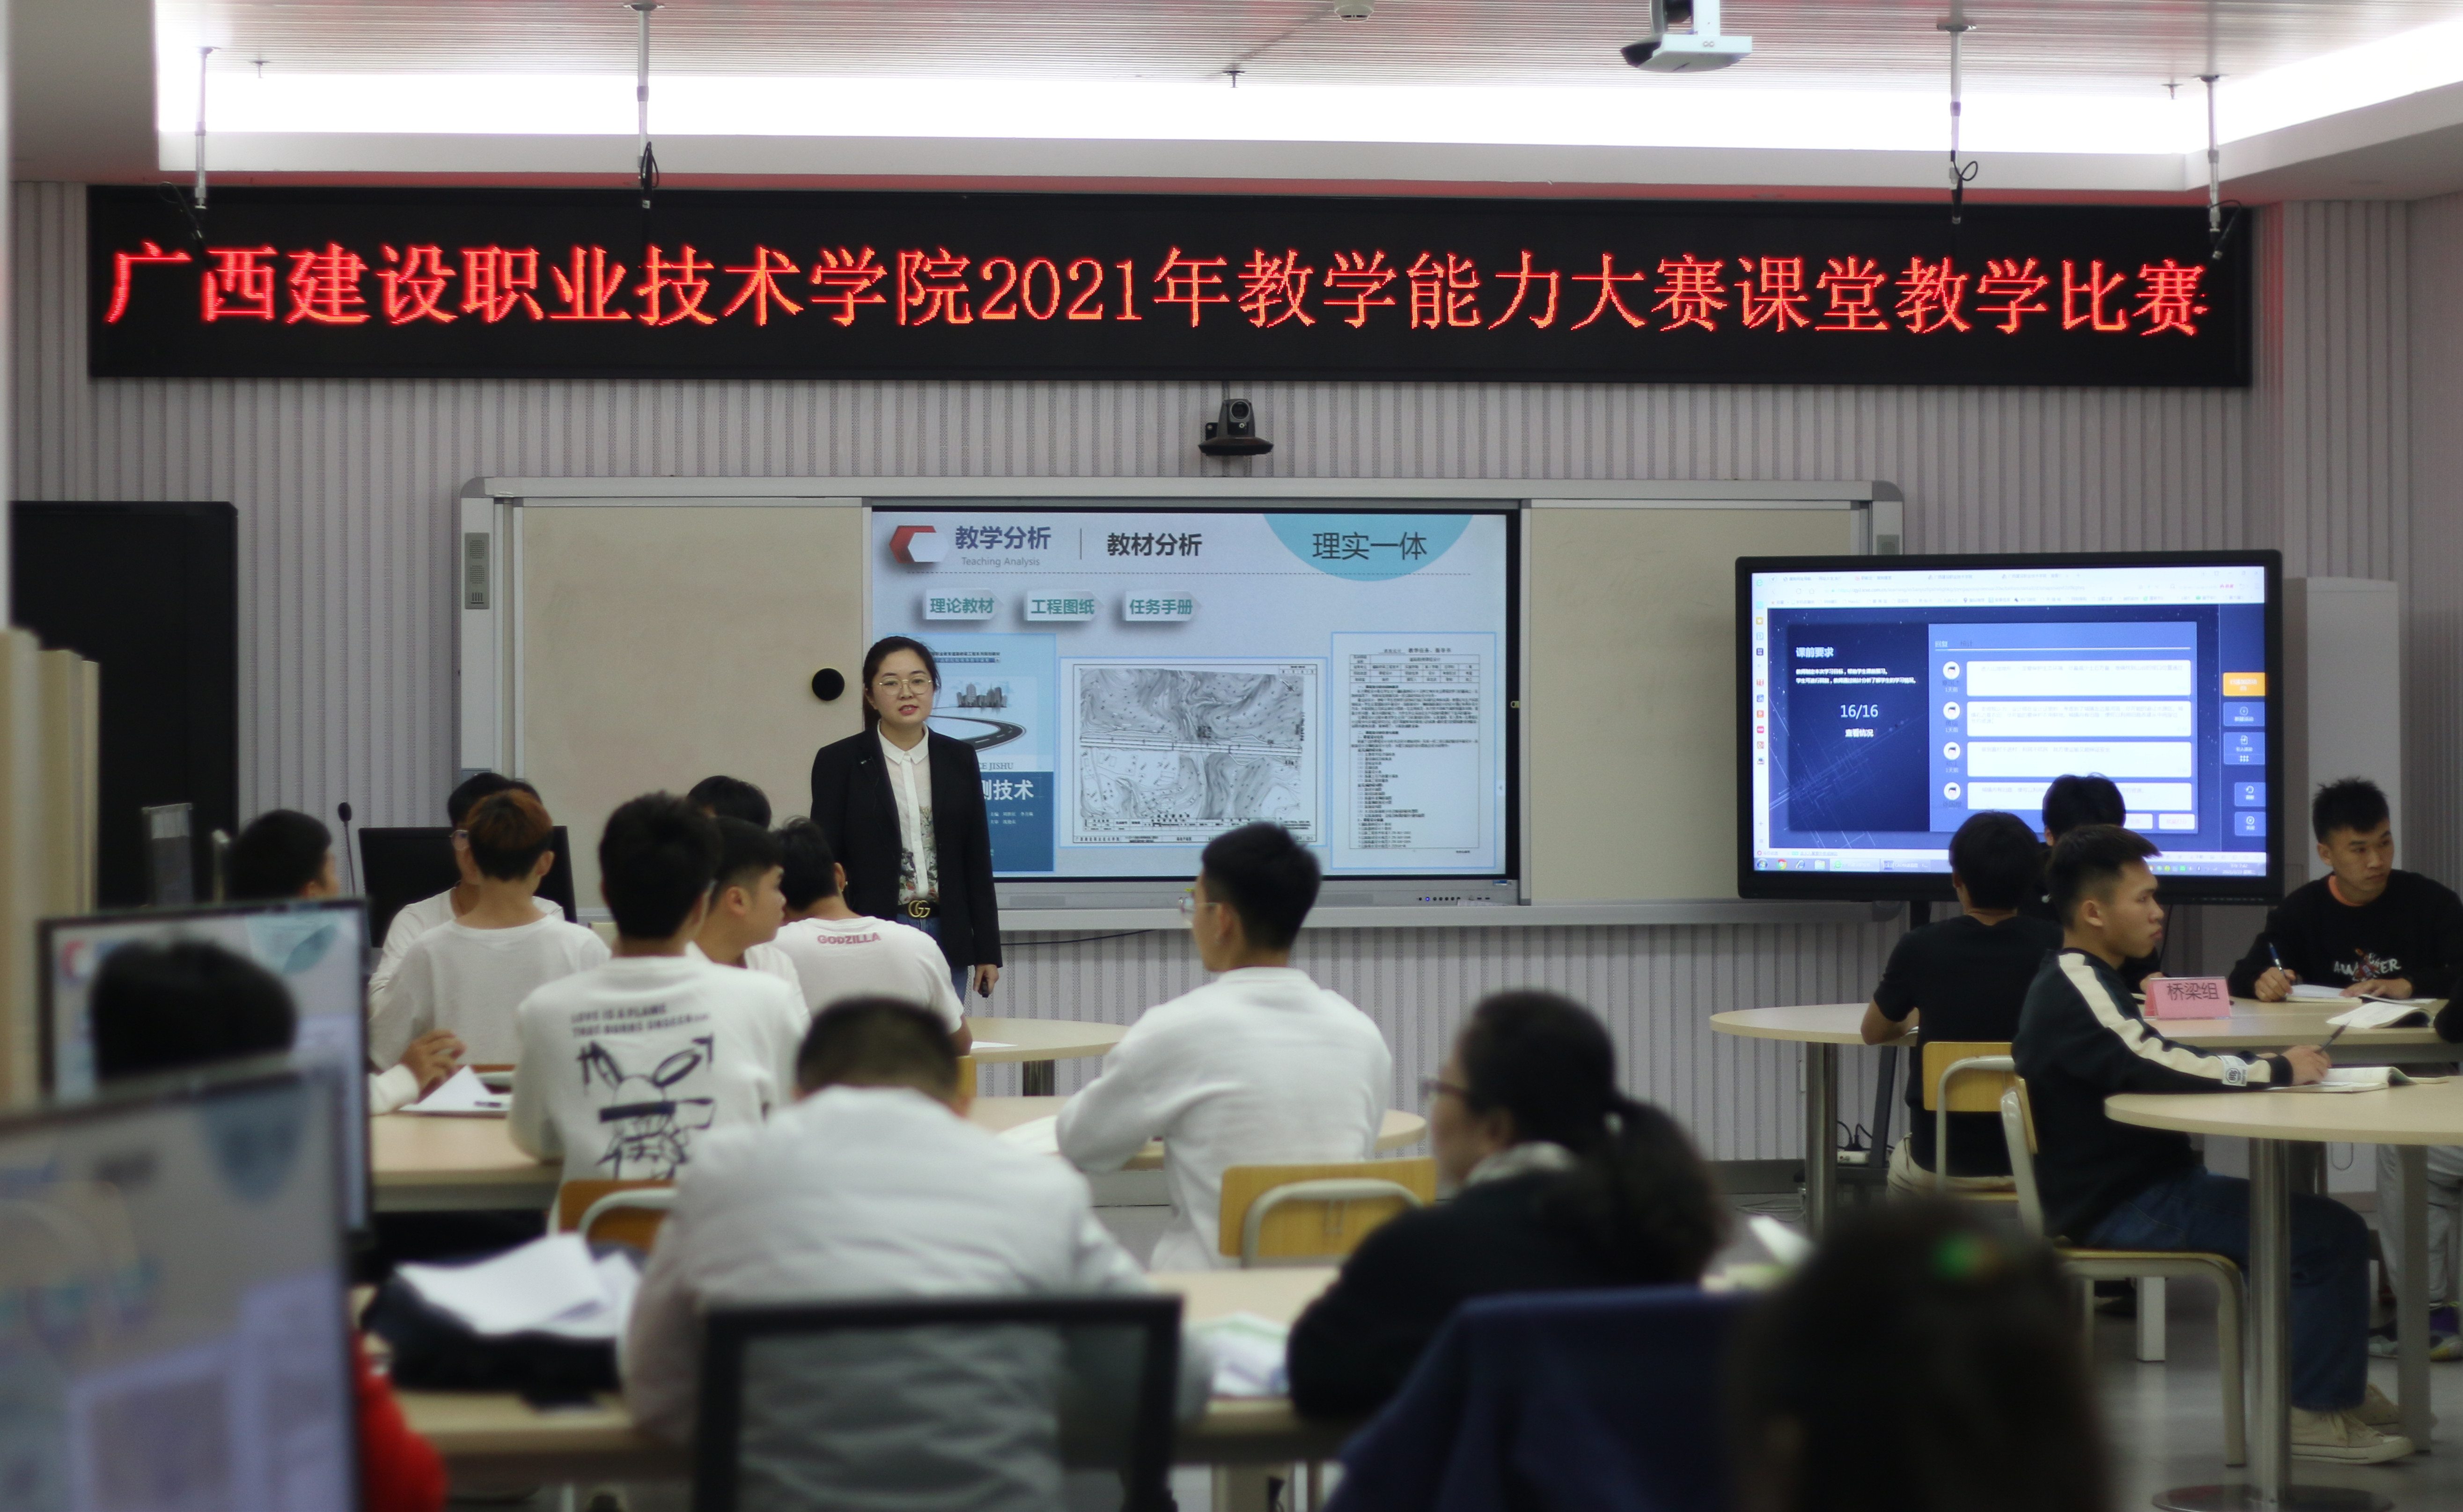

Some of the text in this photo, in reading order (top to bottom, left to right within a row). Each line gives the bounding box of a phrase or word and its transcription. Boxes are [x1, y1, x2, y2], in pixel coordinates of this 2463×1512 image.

[107, 242, 2207, 335] 广西建设职业技术学院2021年教学能力大赛课堂教学比赛
[955, 526, 1051, 550] 教学分析
[1107, 532, 1203, 556] 教材分析
[1312, 531, 1427, 561] 理实一体
[962, 557, 1040, 567] Teaching Analysis
[930, 597, 994, 614] 理论教材
[1031, 599, 1095, 615] 工程图纸
[1129, 599, 1193, 615] 任务手册
[1795, 647, 1834, 658] 课前要求
[1840, 704, 1879, 719] 16/16
[1845, 728, 1874, 738] 查看情况
[817, 932, 881, 944] GODZILLA
[2166, 982, 2219, 1001] 桥梁组
